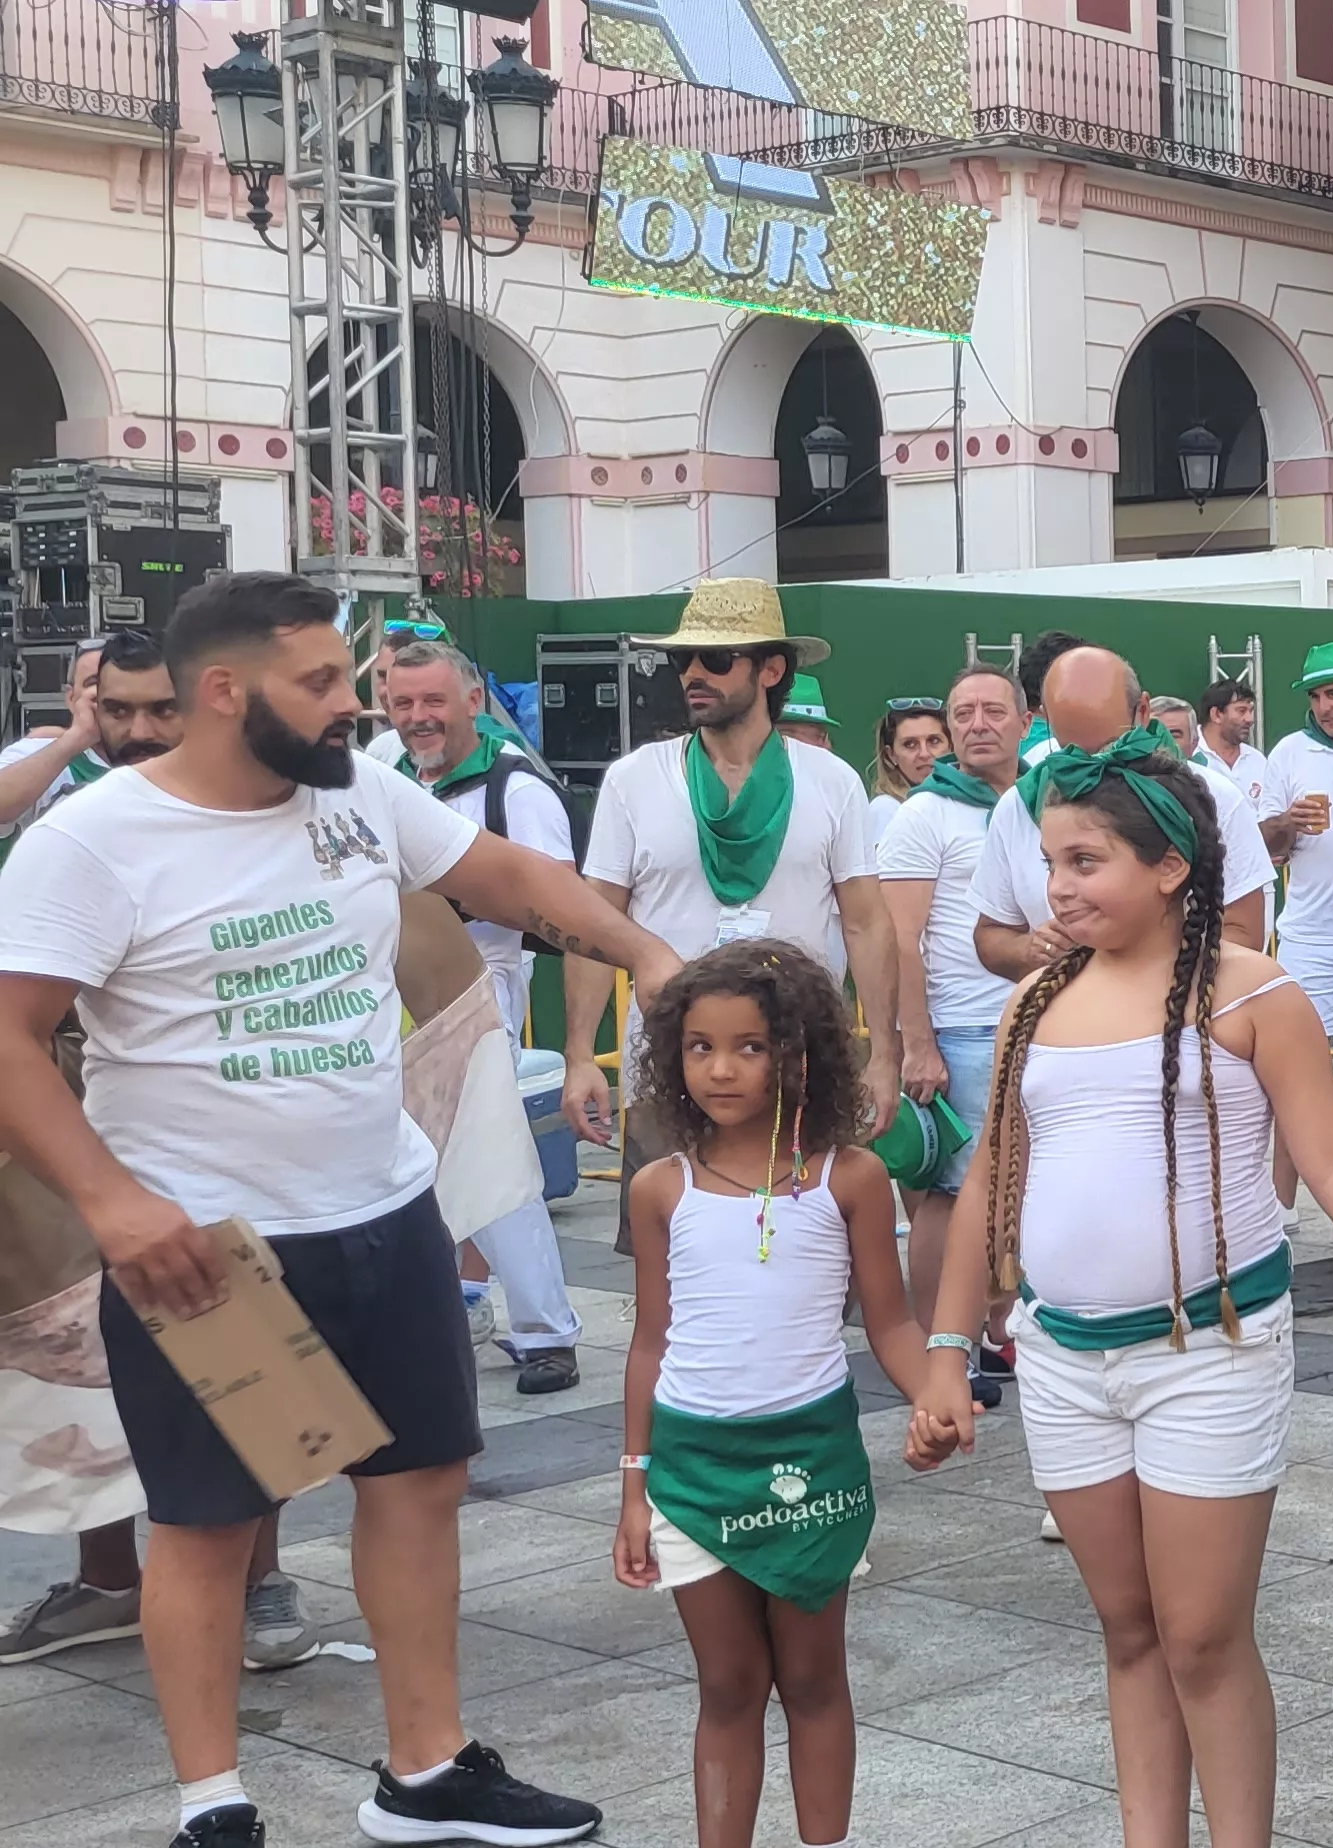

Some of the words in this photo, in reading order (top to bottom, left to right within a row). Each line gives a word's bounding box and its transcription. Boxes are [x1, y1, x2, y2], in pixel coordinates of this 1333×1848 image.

[600, 190, 838, 295] OUR
[210, 899, 335, 951] Gigantes
[214, 1008, 233, 1041] y
[243, 987, 379, 1034] caballitos
[220, 1052, 261, 1082] de
[270, 1038, 376, 1078] huesca
[721, 1484, 867, 1543] podoactiva
[792, 1521, 809, 1533] BY
